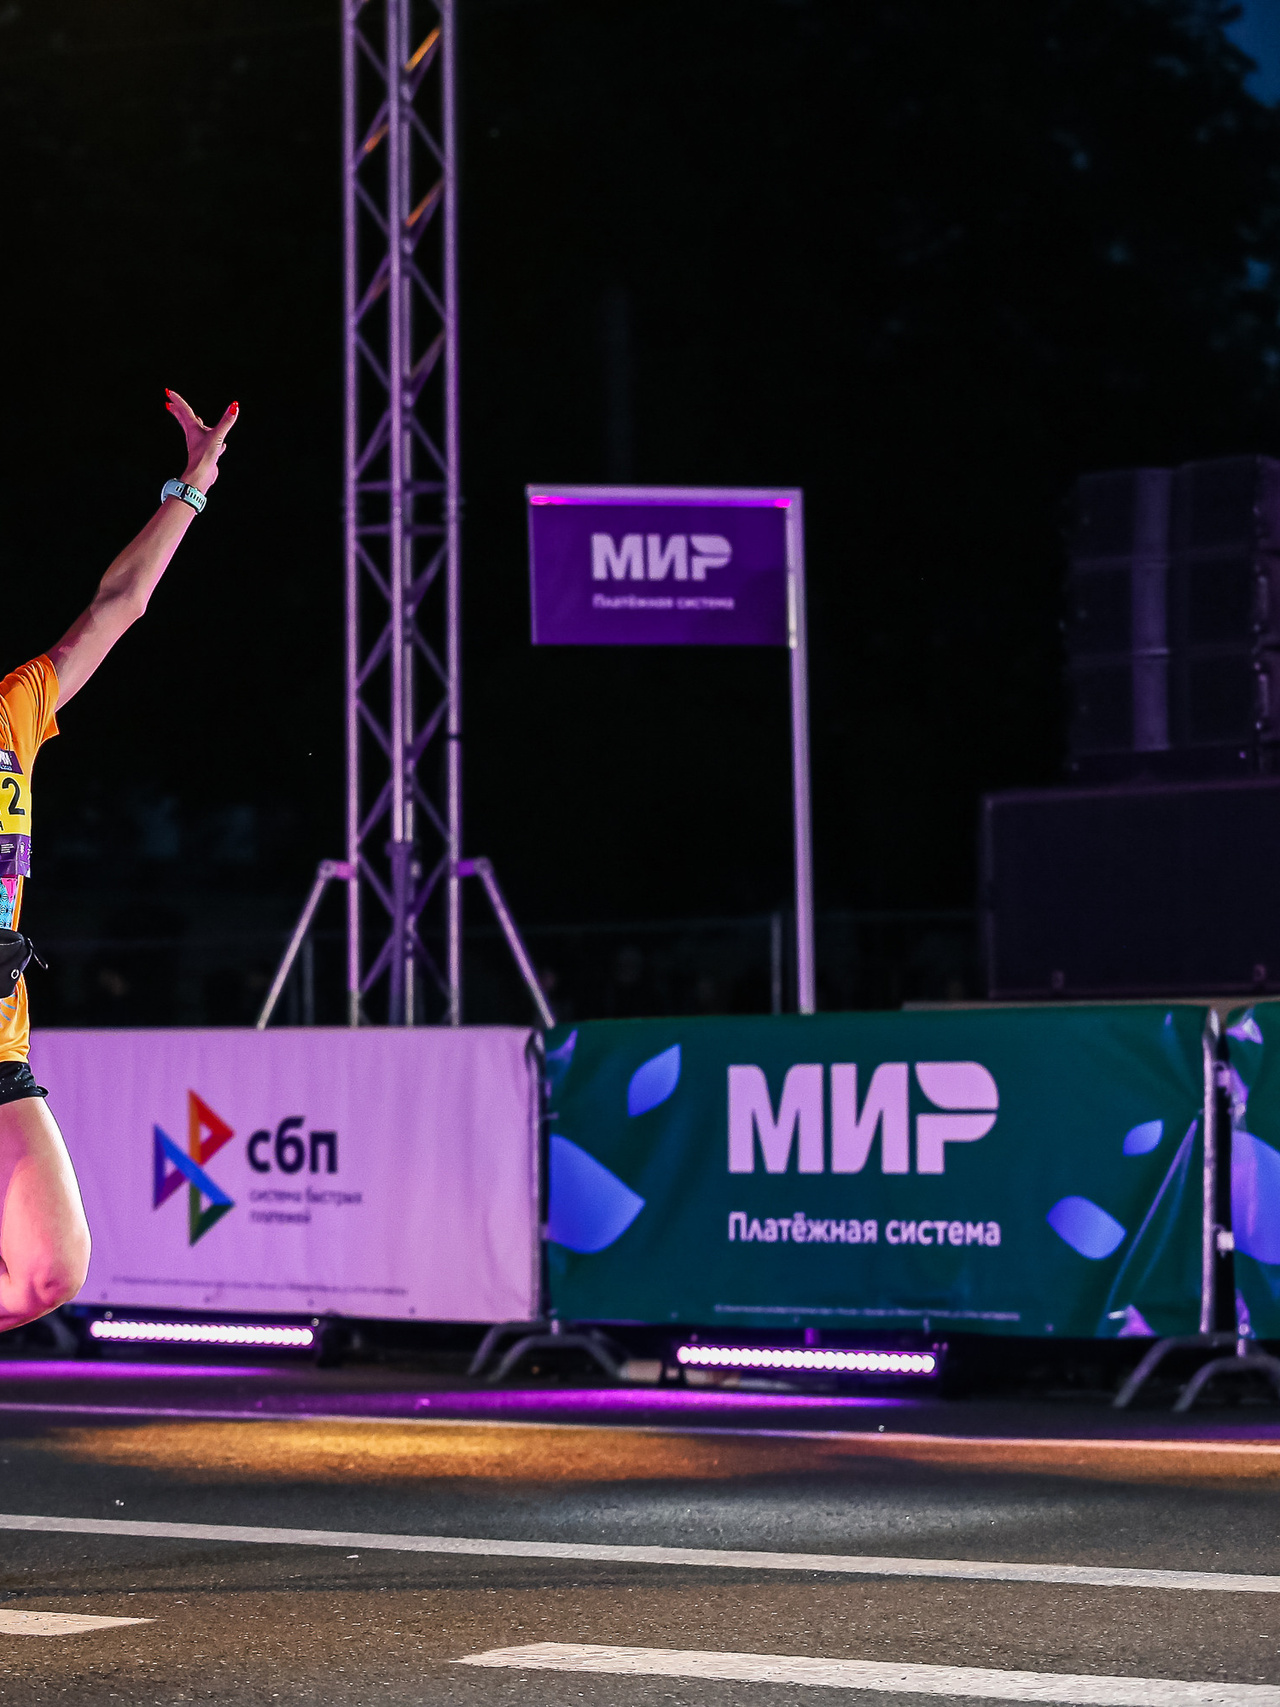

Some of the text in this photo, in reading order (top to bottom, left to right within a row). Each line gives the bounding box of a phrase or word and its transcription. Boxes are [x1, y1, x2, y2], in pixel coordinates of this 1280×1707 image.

[591, 532, 733, 582] МИР
[247, 1115, 338, 1175] сбп
[727, 1061, 1000, 1175] МИР
[728, 1211, 1001, 1247] Платёжная система
